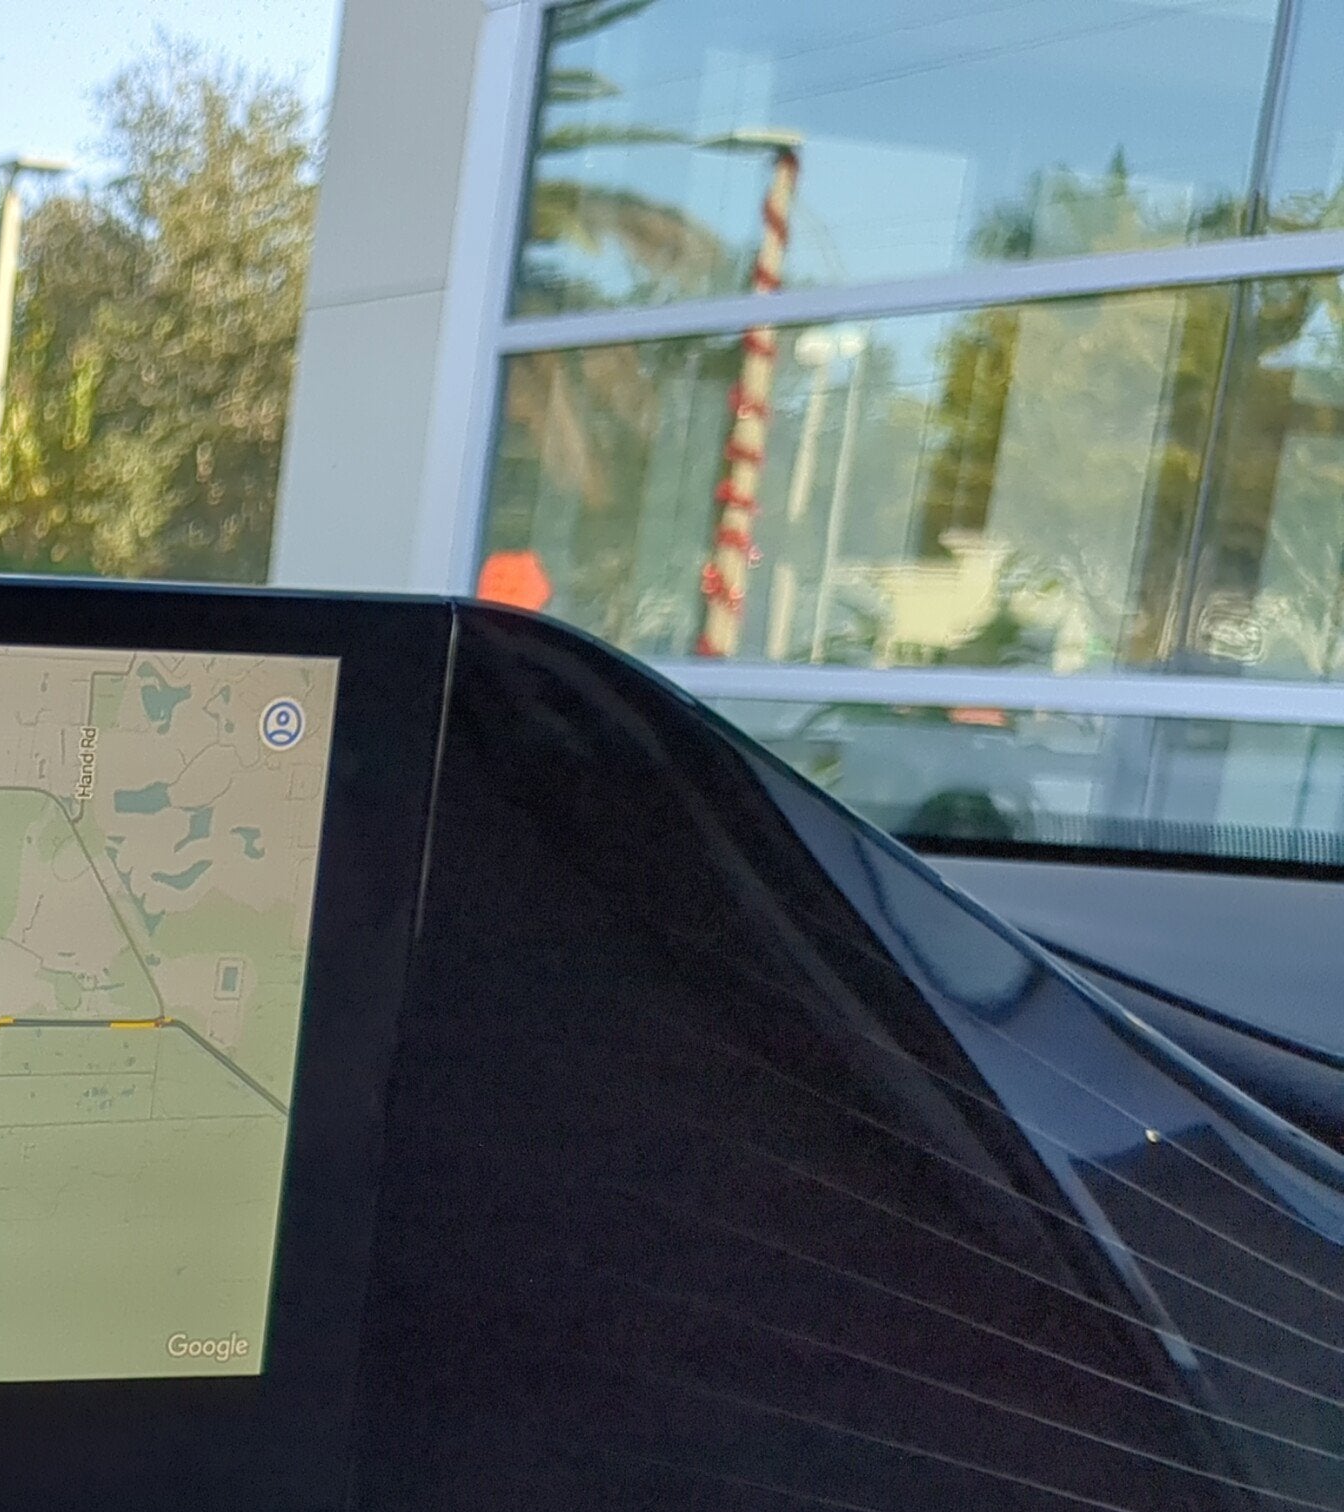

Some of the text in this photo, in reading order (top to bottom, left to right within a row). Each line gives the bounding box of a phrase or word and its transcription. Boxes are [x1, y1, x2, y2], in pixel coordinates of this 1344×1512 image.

[77, 727, 98, 799] Hand Rd
[167, 1332, 249, 1361] Google
